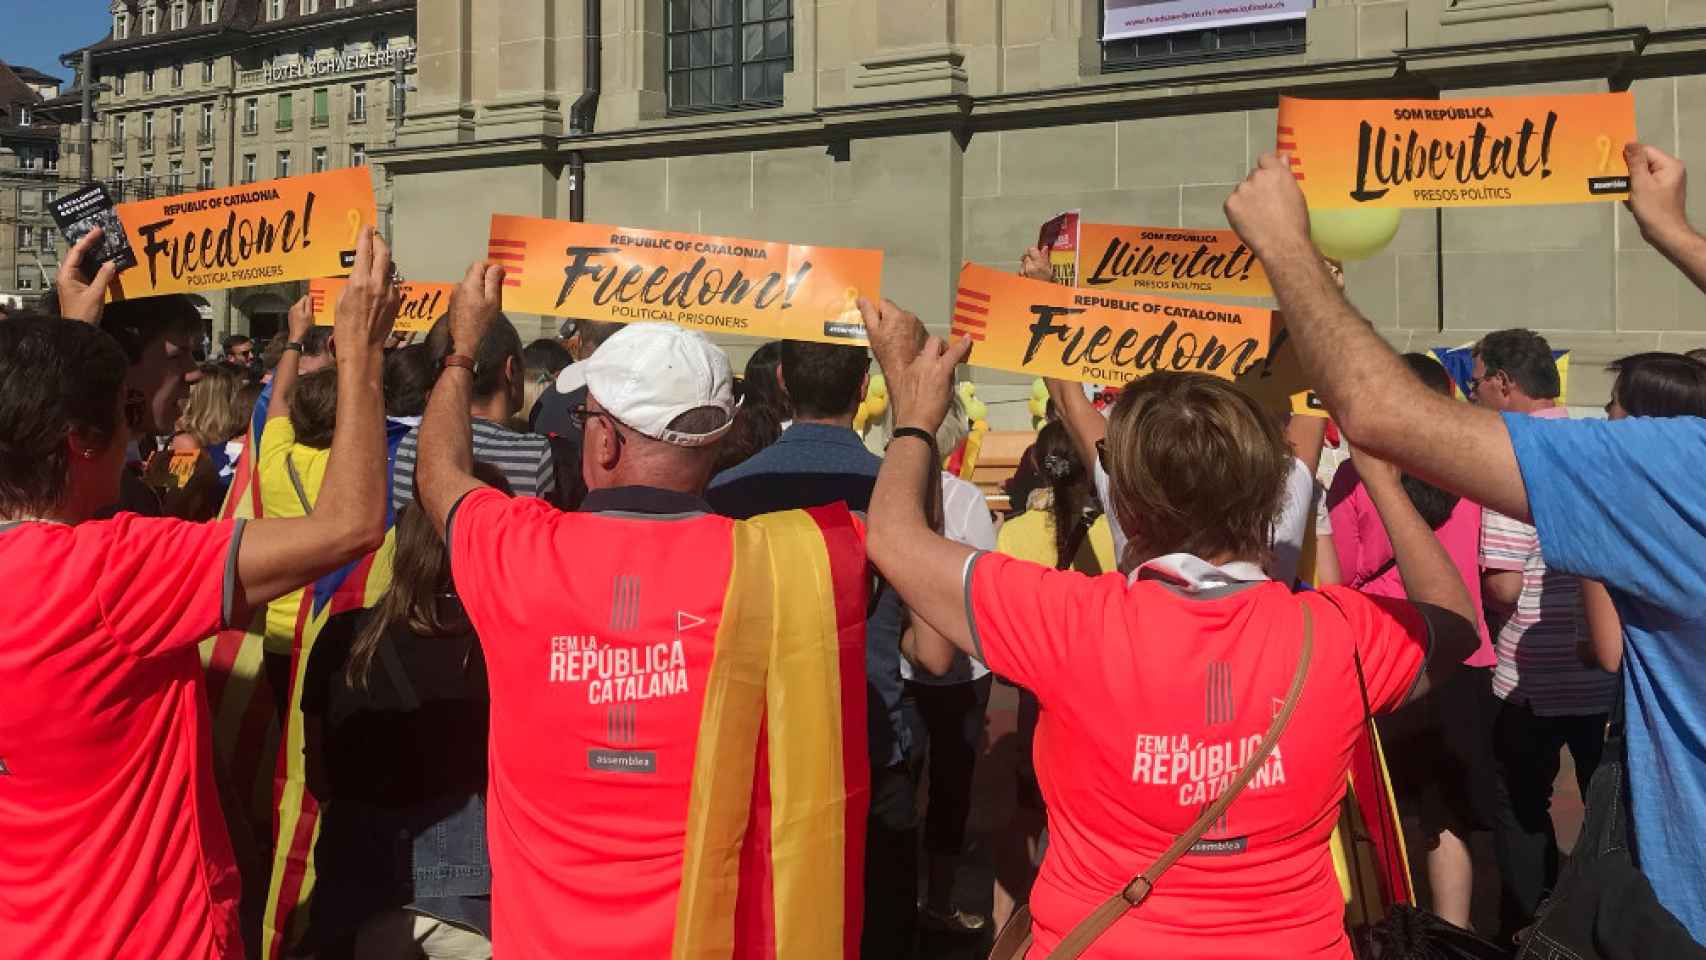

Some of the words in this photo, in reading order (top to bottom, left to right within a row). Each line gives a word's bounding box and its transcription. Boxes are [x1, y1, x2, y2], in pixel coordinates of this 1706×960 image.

[265, 63, 305, 81] HOTEL
[309, 48, 416, 75] SCHWEIZERHOF
[1394, 108, 1424, 120] SOM
[1425, 106, 1493, 121] REPÚBLICA
[1350, 110, 1558, 202] Llibertat!
[164, 199, 208, 215] REPUBLIC
[209, 197, 222, 209] OF
[223, 188, 280, 207] CATALONIA
[1414, 188, 1459, 201] PRESOS
[1460, 186, 1512, 200] POLÍTICS
[138, 191, 315, 290] Freedom!
[610, 233, 672, 250] REPUBLIC
[674, 240, 692, 251] OF
[694, 242, 768, 260] CATALONIA
[1140, 231, 1164, 241] SOM
[1165, 232, 1217, 243] REPÚBLICA
[1087, 237, 1255, 286] Llibertat!
[187, 272, 231, 286] POLITICAL
[232, 265, 284, 281] PRISONERS
[554, 246, 812, 310] Freedom!
[1134, 279, 1170, 290] PRESOS
[611, 306, 674, 321] POLITICAL
[677, 311, 749, 328] PRISONERS
[1074, 295, 1139, 313] REPUBLIC
[1143, 303, 1161, 315] OF
[1164, 307, 1242, 325] CATALONIA
[1022, 304, 1290, 378] Freedom!
[1082, 366, 1141, 383] POLITIC
[552, 635, 578, 651] FEM
[581, 635, 598, 650] LA
[550, 639, 686, 682] REPÚBLICA
[588, 668, 688, 704] CATALANA
[1136, 734, 1168, 753] FEM
[1172, 733, 1190, 752] LA
[596, 754, 649, 767] assemblea
